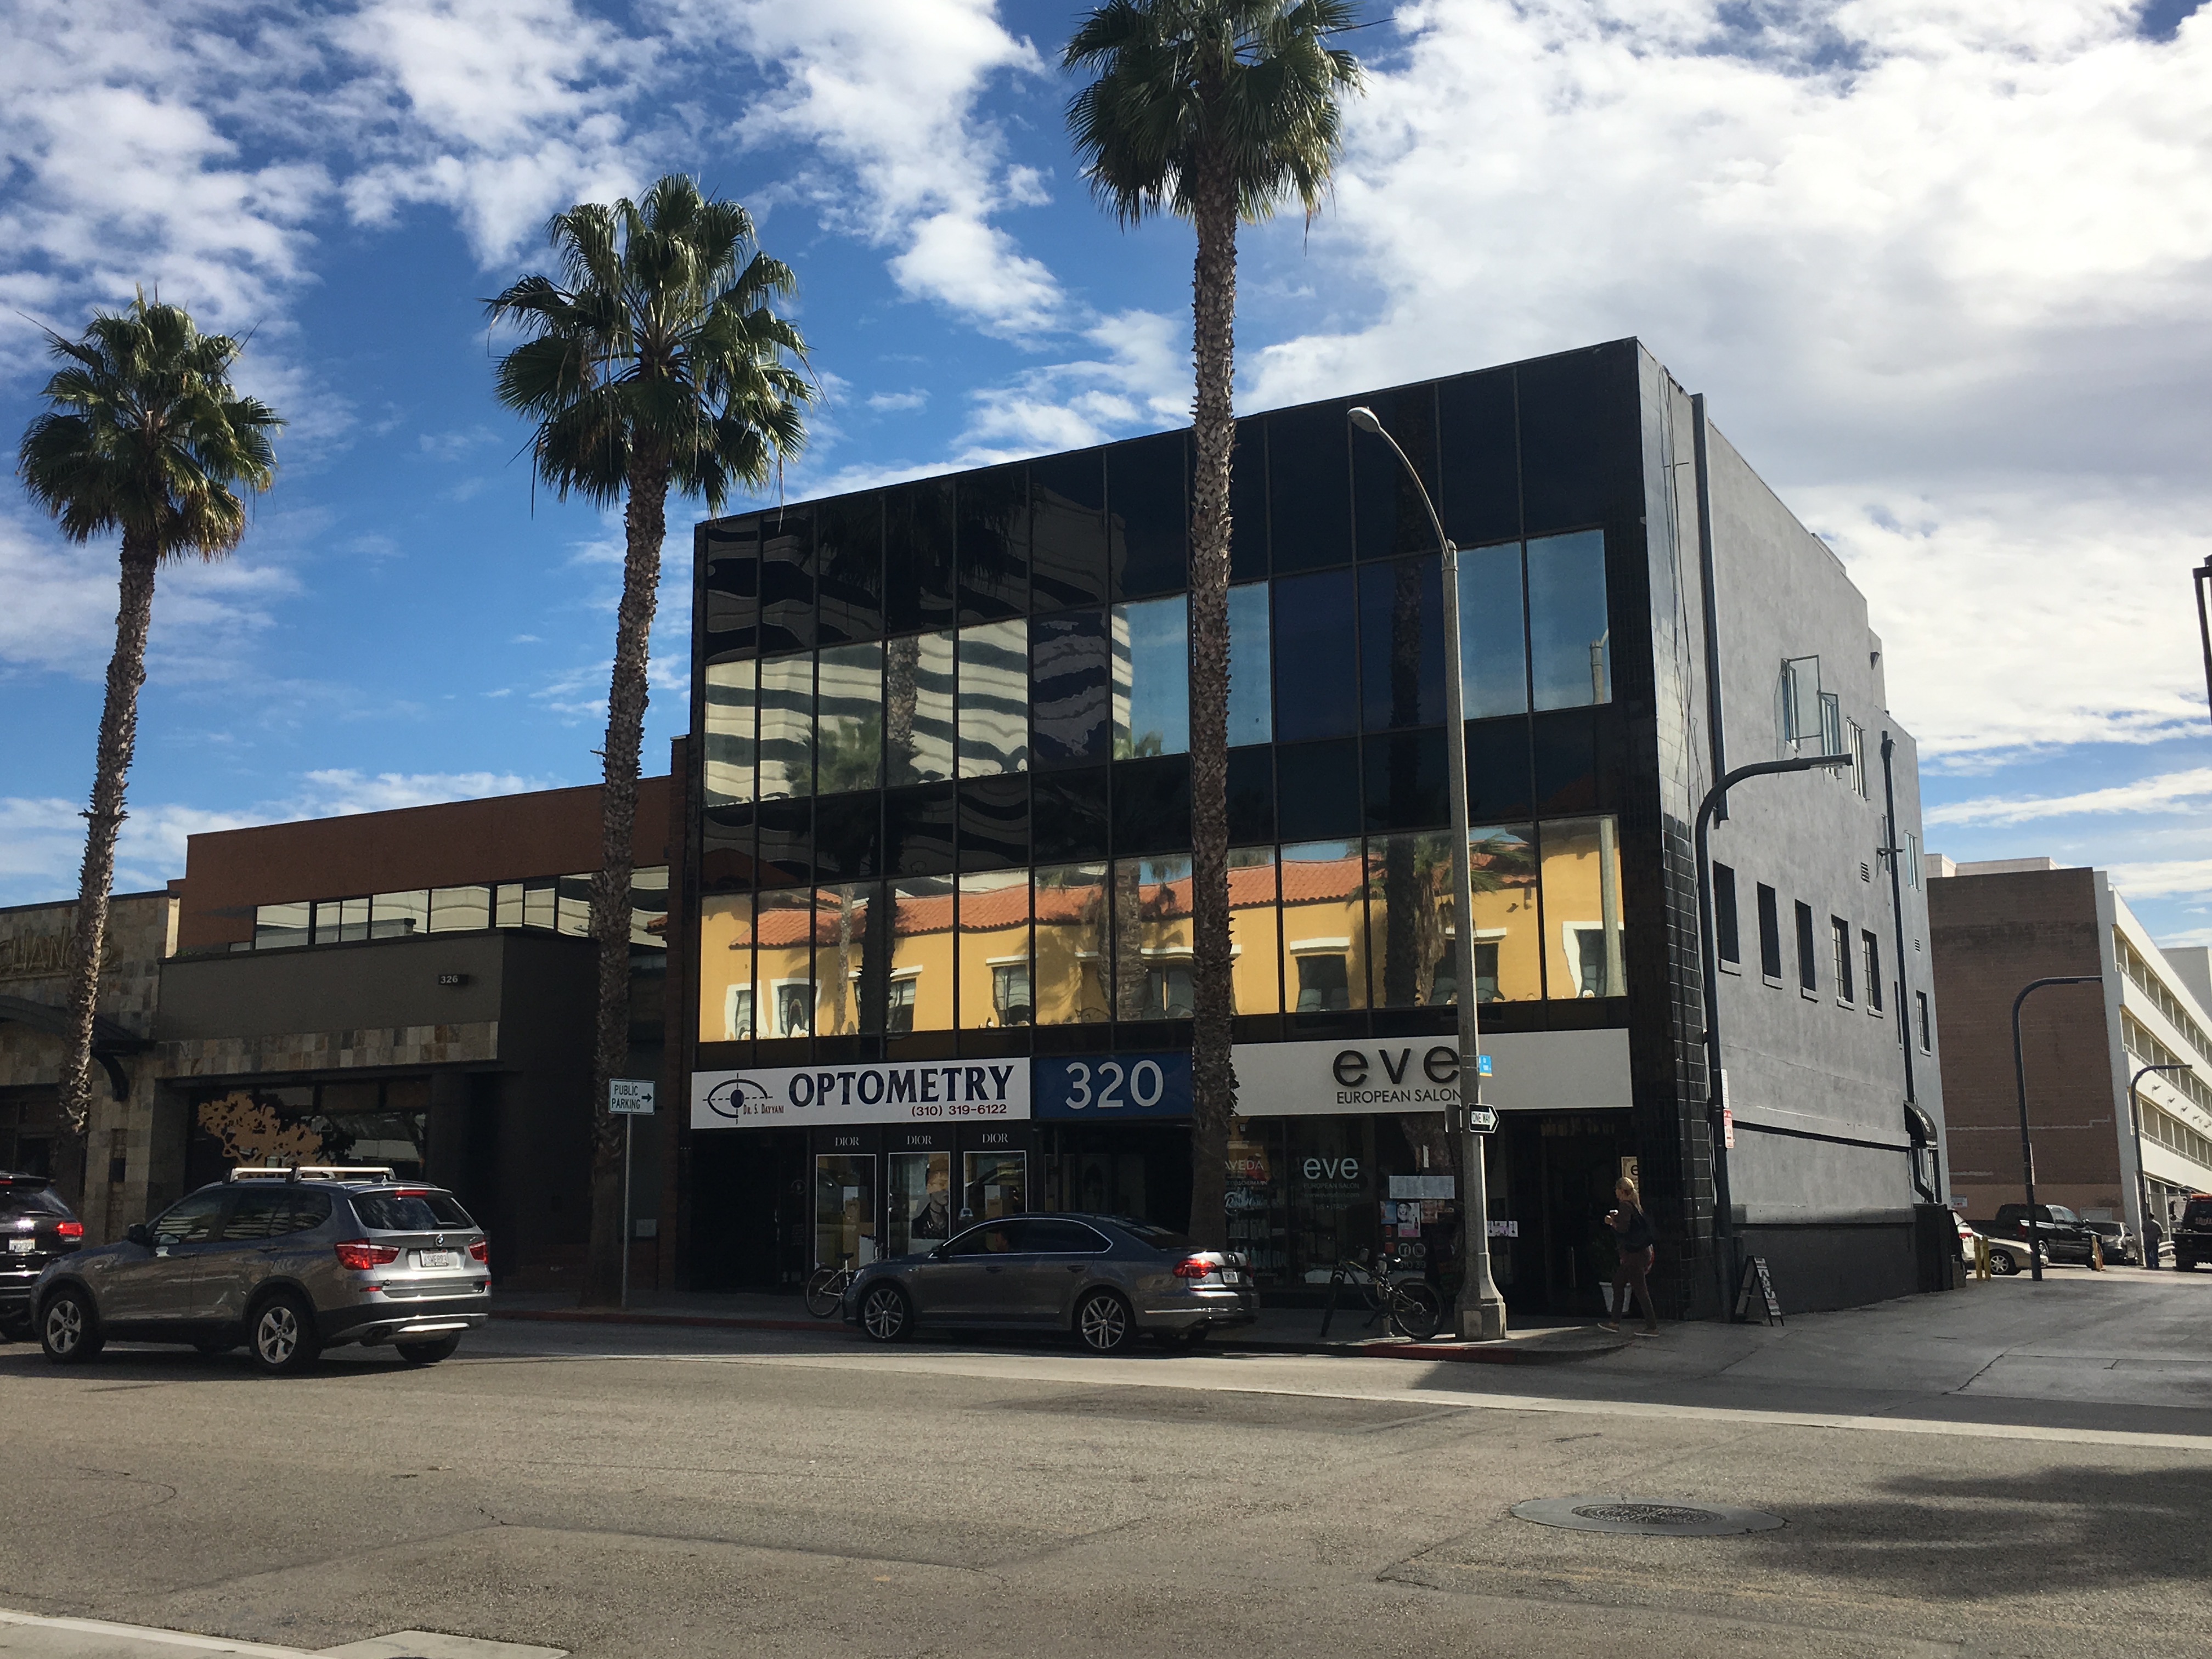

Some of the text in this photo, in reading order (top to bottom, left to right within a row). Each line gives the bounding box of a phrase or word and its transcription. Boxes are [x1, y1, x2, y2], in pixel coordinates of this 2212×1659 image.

[440, 975, 459, 984] 326
[1333, 1046, 1459, 1087] eve
[788, 1065, 1014, 1107] OPTOMETRY
[1065, 1059, 1164, 1109] 320
[614, 1085, 638, 1096] PUBLIC
[1336, 1088, 1461, 1104] EUROPEAN SALON
[612, 1098, 641, 1109] PARKING
[911, 1103, 1007, 1116] (310) 319-6122
[1472, 1112, 1482, 1123] ONE
[835, 1137, 860, 1147] DIOR
[907, 1135, 932, 1145] DIOR
[983, 1133, 1008, 1143] DIOR
[1303, 1158, 1359, 1180] eve
